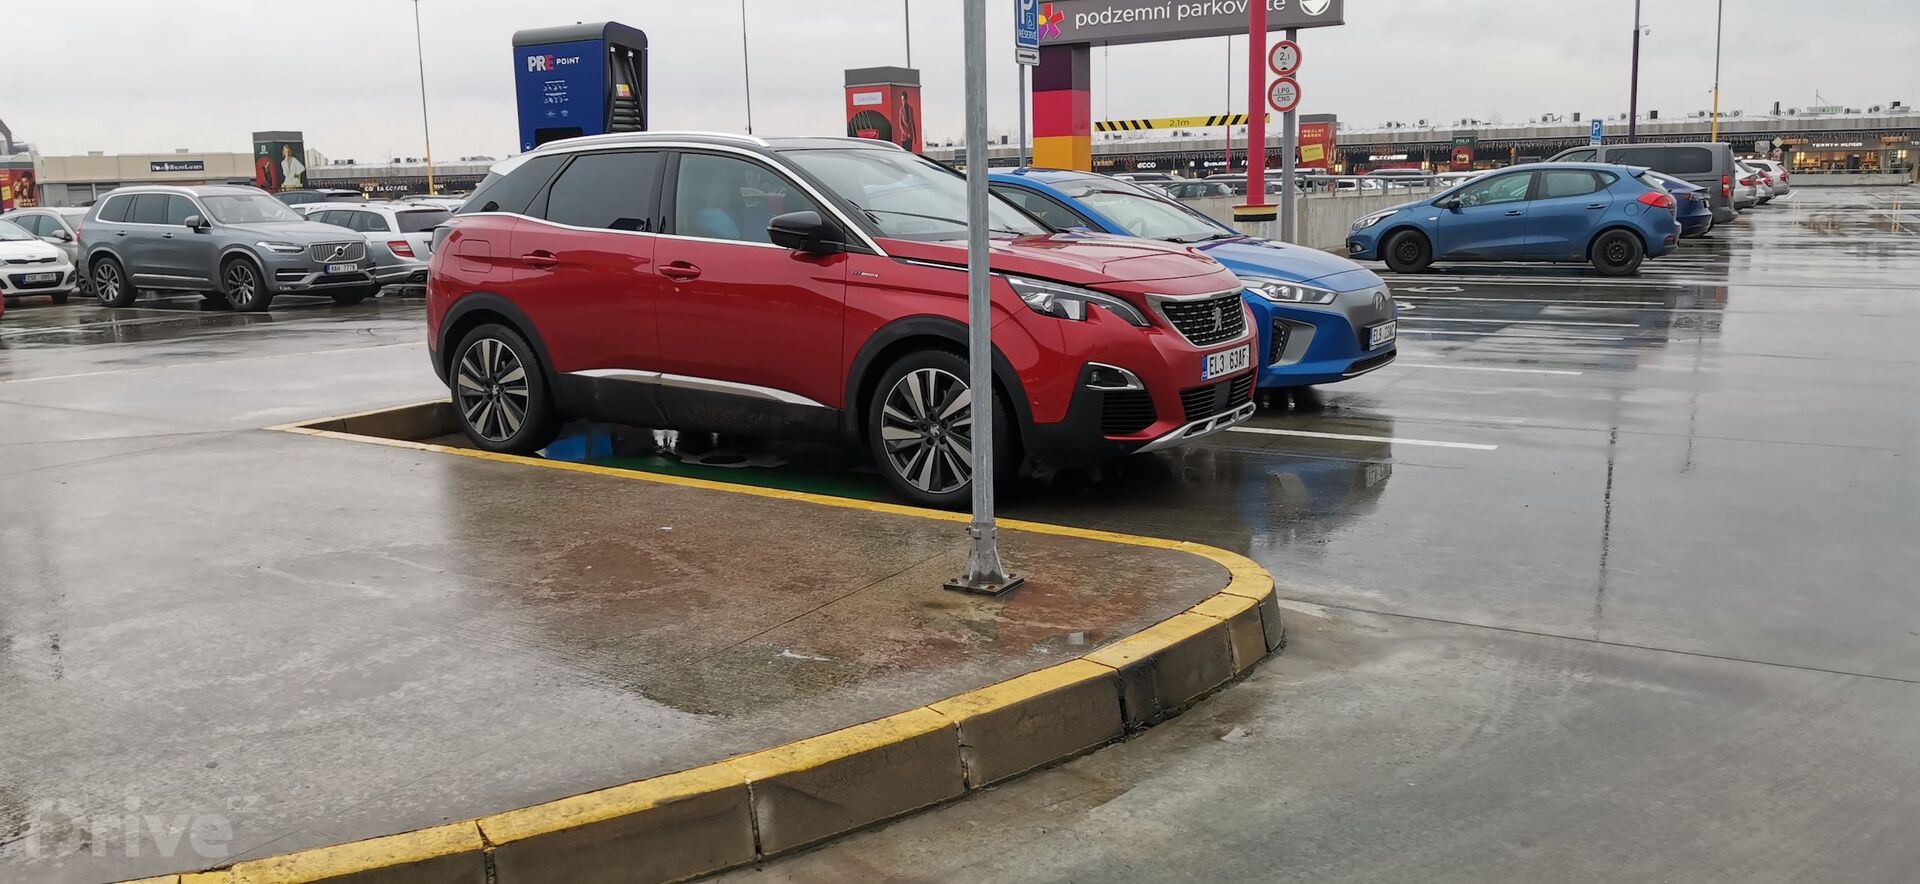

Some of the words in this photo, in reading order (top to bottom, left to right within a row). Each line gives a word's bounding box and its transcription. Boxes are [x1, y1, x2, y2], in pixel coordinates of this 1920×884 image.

[1075, 1, 1171, 29] podzemní
[527, 54, 554, 72] PRE
[556, 56, 580, 65] POINT
[1592, 121, 1600, 135] P
[1210, 354, 1225, 376] EL3
[1230, 348, 1246, 370] 63AF
